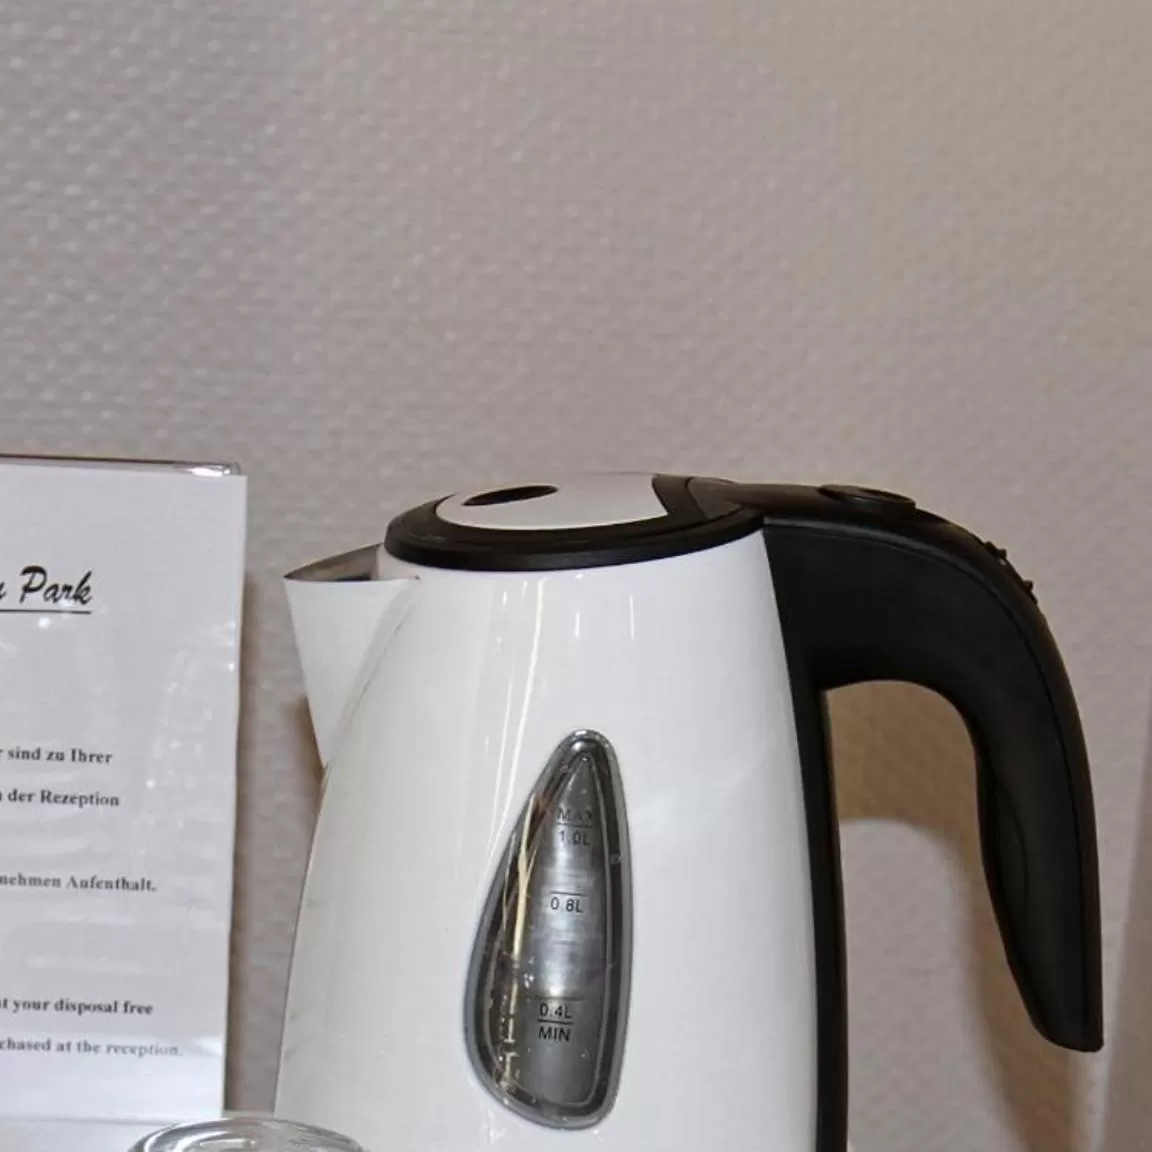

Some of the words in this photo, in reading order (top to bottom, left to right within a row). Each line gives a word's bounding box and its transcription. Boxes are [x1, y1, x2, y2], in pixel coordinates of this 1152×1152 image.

[19, 565, 93, 605] Park
[8, 746, 42, 761] sind
[45, 751, 65, 762] zu
[70, 748, 113, 764] Ihrer
[7, 788, 36, 803] der
[40, 789, 120, 808] Rezeption
[66, 875, 157, 892] Aufenthalt.
[12, 1000, 51, 1013] your
[54, 998, 119, 1016] disposal
[122, 1000, 154, 1015] free
[539, 1002, 573, 1020] 0.4L
[538, 1026, 572, 1043] MIN
[56, 1041, 72, 1052] at
[76, 1040, 100, 1054] the
[106, 1044, 181, 1058] reception.
